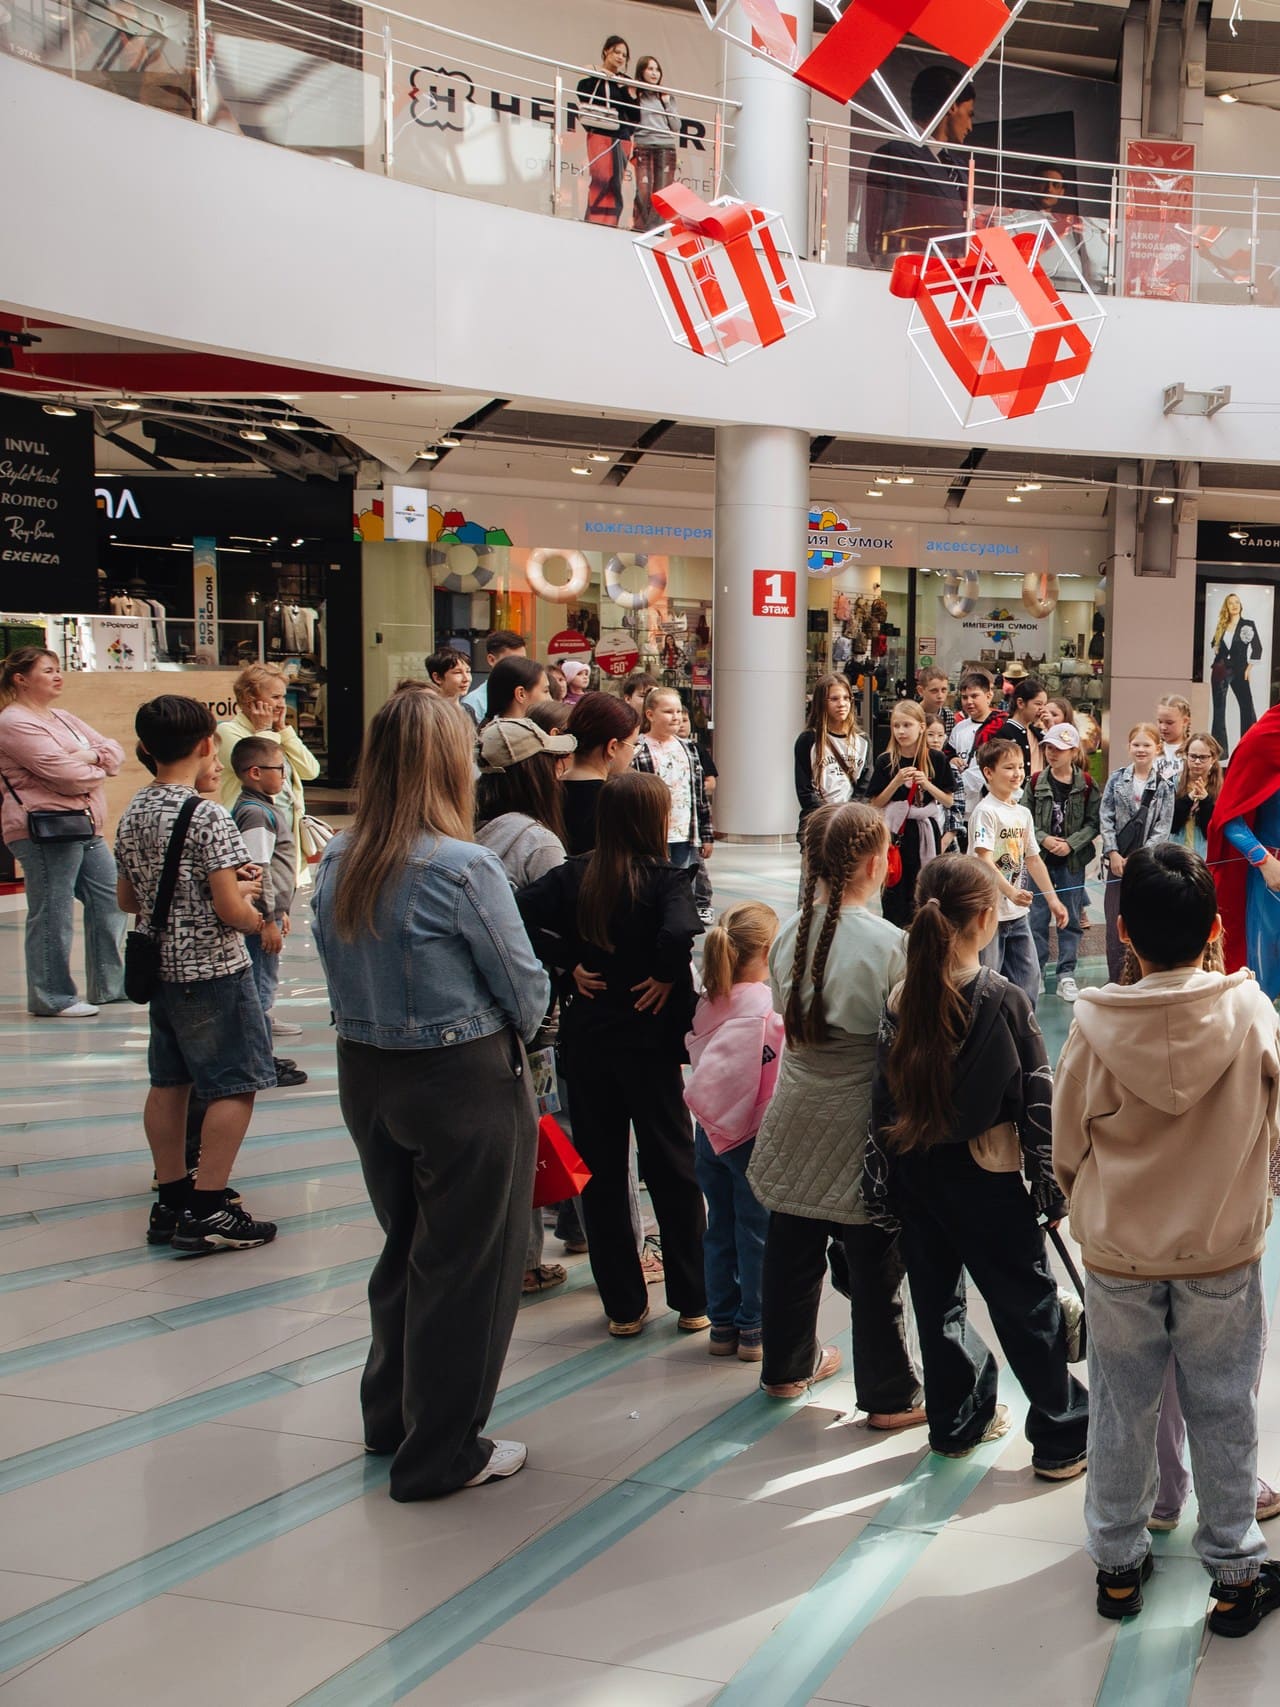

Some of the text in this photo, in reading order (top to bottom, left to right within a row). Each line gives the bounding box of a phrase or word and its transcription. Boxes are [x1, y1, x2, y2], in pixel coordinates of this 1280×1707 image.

[4, 515, 55, 543] Ray-Ban
[584, 521, 713, 541] кожгалантерея
[837, 536, 894, 549] СУМОК
[926, 540, 1020, 556] аксессуары
[1239, 538, 1280, 548] САЛОН
[2, 549, 60, 565] EXENZA
[764, 573, 788, 604] 1
[761, 604, 790, 615] этаж
[962, 621, 1038, 631] ИМПЕРИЯ СУМОК
